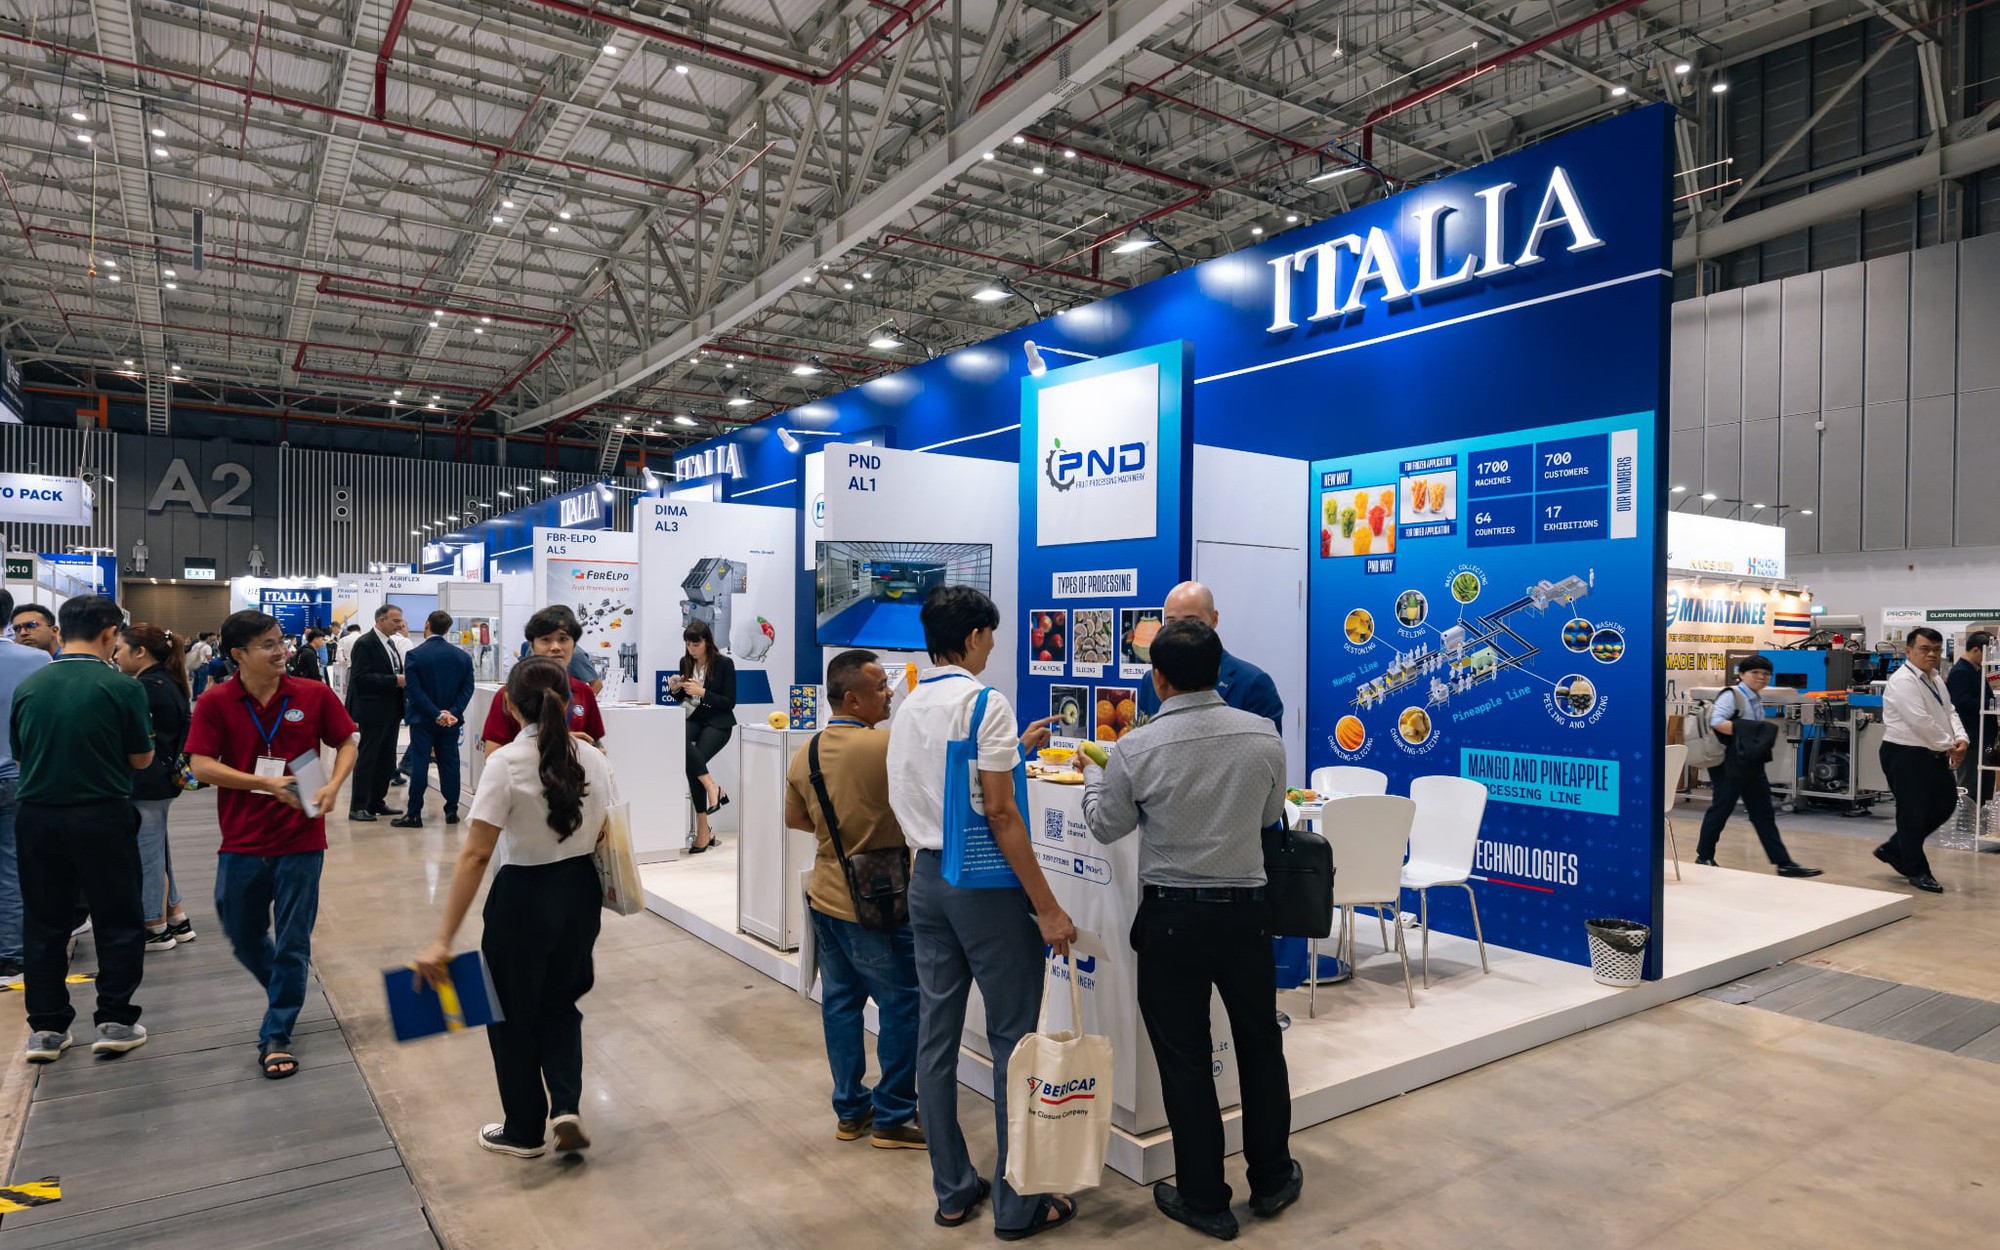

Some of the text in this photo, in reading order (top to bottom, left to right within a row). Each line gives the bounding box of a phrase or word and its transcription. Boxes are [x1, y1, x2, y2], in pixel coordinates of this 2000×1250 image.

[1266, 166, 1606, 333] ITALIA
[674, 442, 743, 482] ITALIA
[849, 453, 881, 470] PND
[1058, 442, 1145, 481] PND
[1545, 452, 1572, 467] 700
[1477, 460, 1509, 475] 1700
[1544, 467, 1589, 479] CUSTOMERS
[848, 476, 876, 491] AL1
[1118, 473, 1145, 483] MACHINERY
[1324, 471, 1350, 487] NEW WAY
[1475, 476, 1511, 487] MACHINES
[1617, 456, 1632, 512] OUR NUMBERS
[0, 487, 63, 501] O PACK
[148, 458, 252, 516] A2
[560, 491, 600, 527] ITALIA
[655, 504, 688, 517] DIMA
[1545, 506, 1562, 519] 17
[1475, 512, 1492, 525] 64
[1543, 520, 1599, 531] EXHIBITIONS
[655, 521, 679, 532] AL3
[1475, 526, 1515, 537] COUNTRIES
[546, 532, 597, 543] FBR-ELPO
[546, 546, 566, 554] AL5
[187, 569, 213, 577] EXIT
[1367, 559, 1393, 573] PND WAY
[1445, 563, 1489, 588] WASTE COLLECTING
[1058, 573, 1131, 594] TYPES OF PROCESSING
[264, 591, 310, 602] ITALIA
[1679, 598, 1767, 625] MAHATANEE
[1397, 628, 1426, 639] PEELING
[1596, 620, 1626, 634] WASHING
[1343, 642, 1376, 655] DESTONING
[1666, 652, 1694, 670] MADE
[1697, 652, 1707, 670] IN
[1332, 661, 1379, 688] Mango line
[1452, 685, 1531, 723] Pineapple line
[1544, 693, 1609, 729] PEELING AND CORING
[1327, 735, 1373, 761] CHUNKING-SLICING
[1390, 728, 1441, 755] CHUNKING-SLICING
[1468, 753, 1608, 791] MANGO AND PINEAPPLE
[1484, 784, 1582, 805] CESSING LINE
[1067, 821, 1087, 830] Youtube
[1067, 830, 1087, 839] channel
[1475, 839, 1578, 886] ECHNOLOGIES
[1061, 969, 1096, 991] MAINERY
[1042, 1078, 1096, 1098] BERICAP
[1028, 1107, 1088, 1120] he Closure Company
